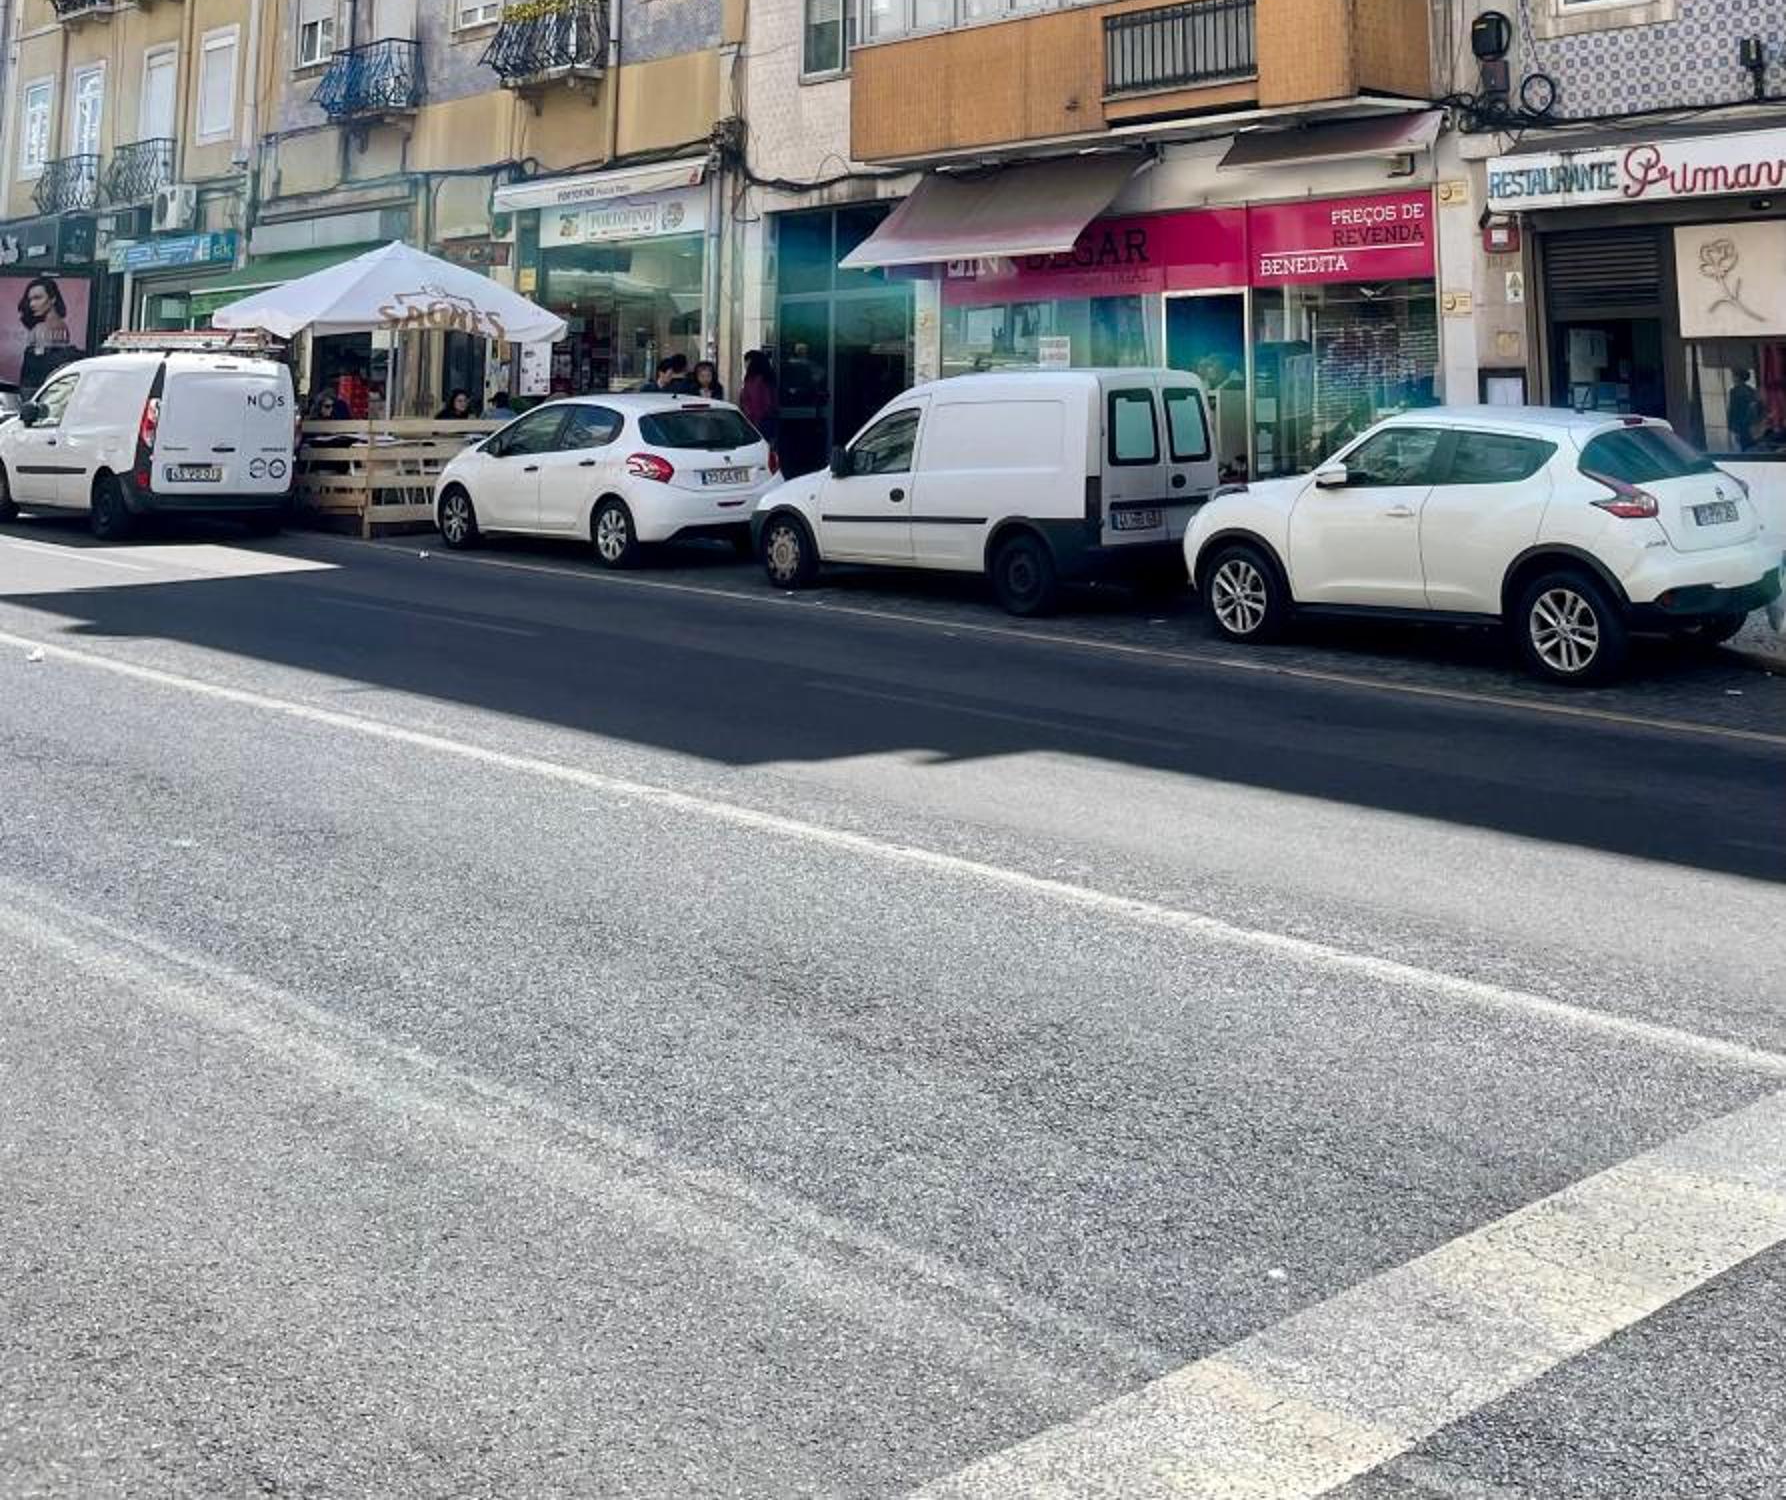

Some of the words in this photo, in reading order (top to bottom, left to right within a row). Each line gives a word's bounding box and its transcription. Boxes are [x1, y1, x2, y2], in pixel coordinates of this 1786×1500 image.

[1489, 161, 1618, 198] RESTAURANTE
[591, 208, 654, 229] PORTOFINO
[1331, 205, 1397, 226] PREÇOS
[1402, 203, 1425, 219] DE
[1332, 223, 1425, 246] REVENDA
[1260, 255, 1349, 276] BENEDITA
[247, 390, 285, 412] NOS
